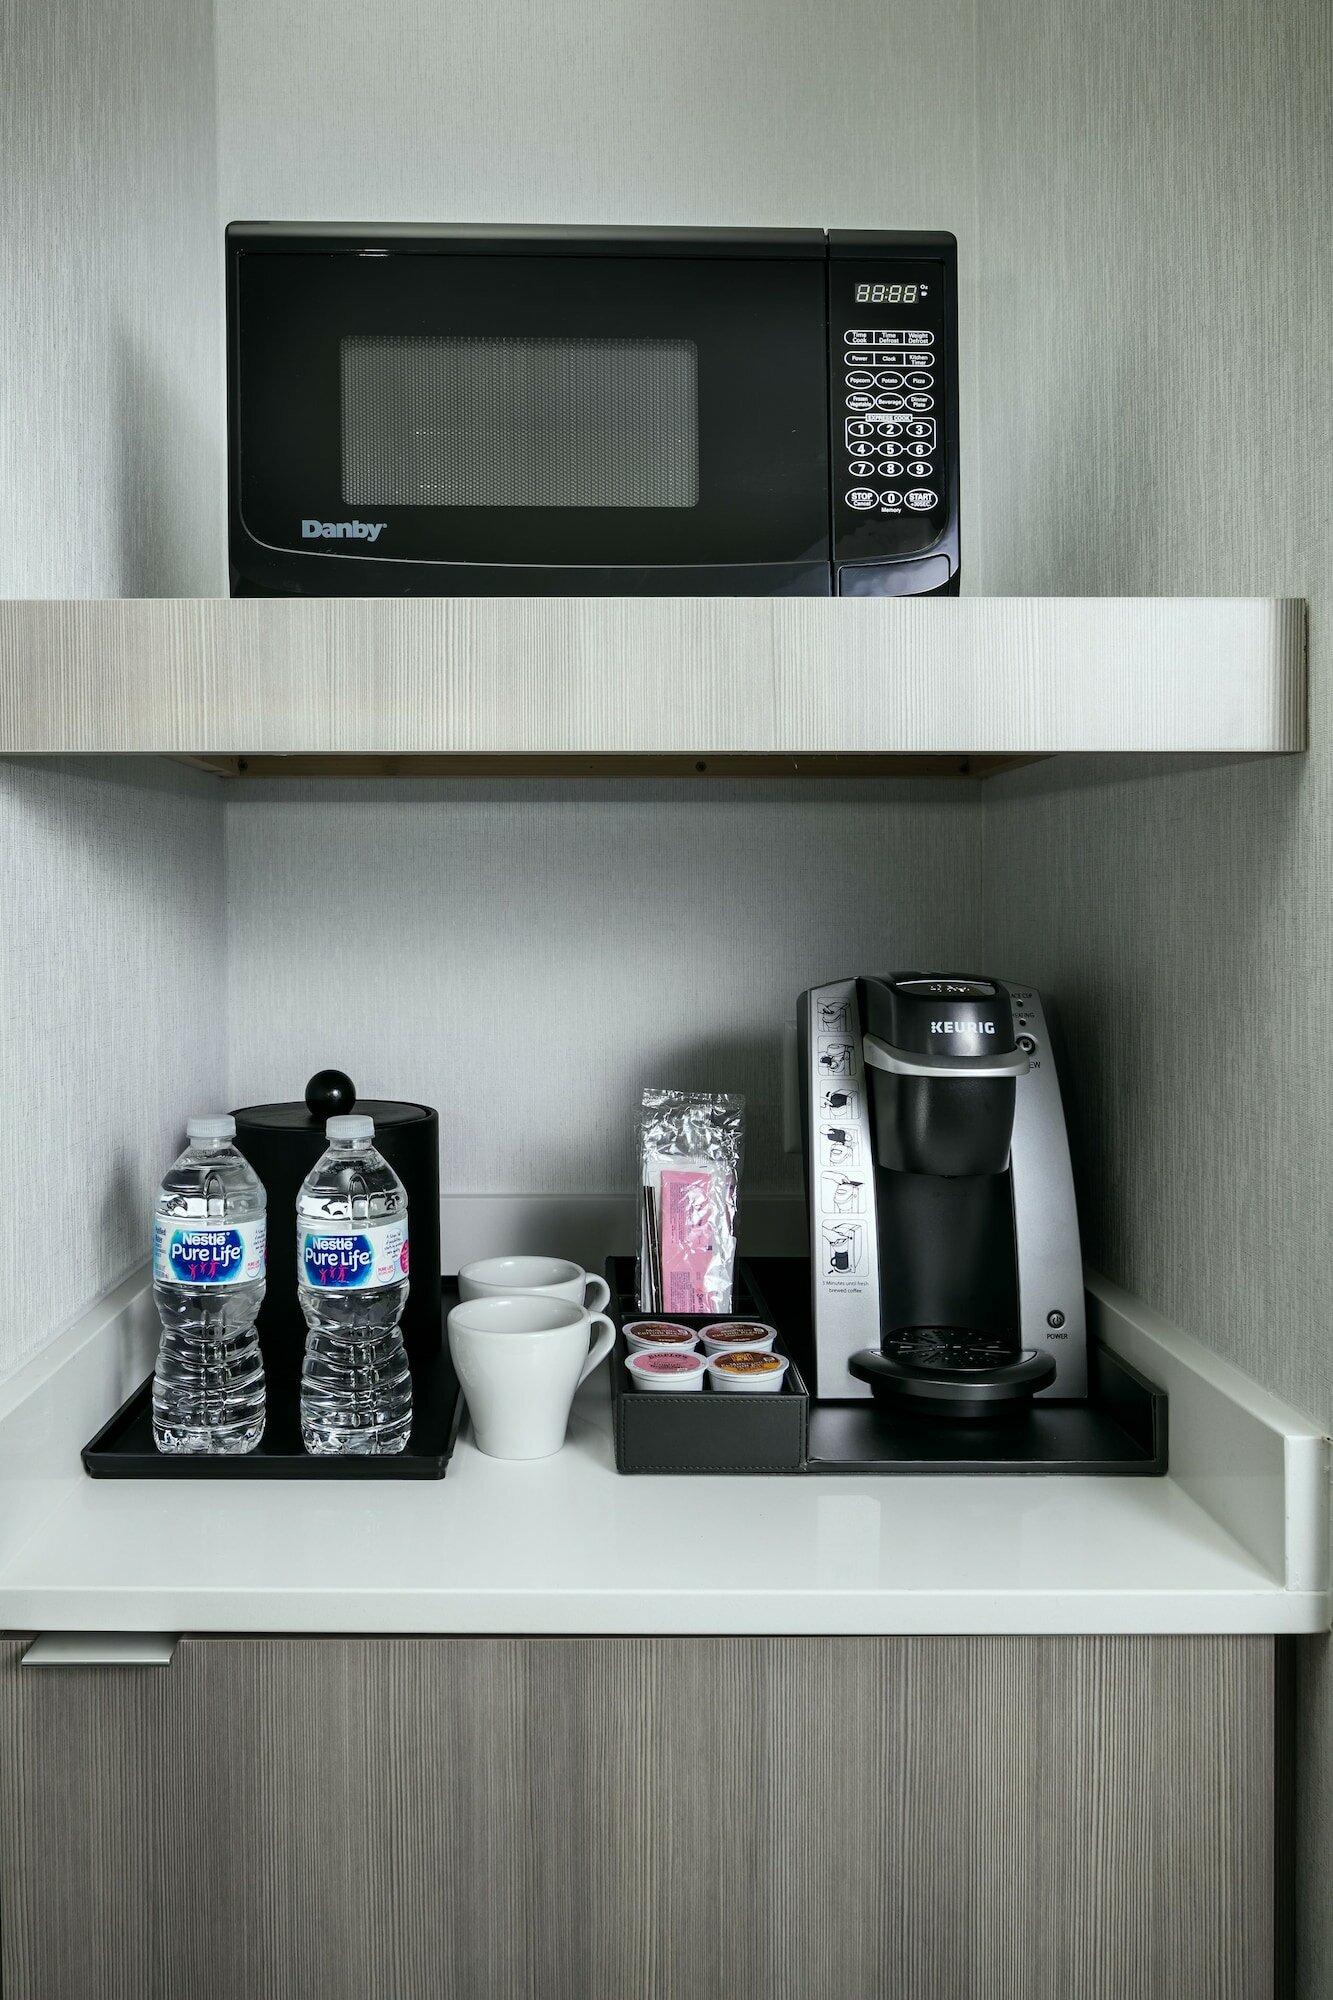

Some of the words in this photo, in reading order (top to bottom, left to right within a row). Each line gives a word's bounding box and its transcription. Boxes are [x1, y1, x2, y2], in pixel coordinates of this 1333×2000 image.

[858, 424, 864, 434] 1
[886, 424, 894, 434] 2
[915, 424, 923, 435] 3
[857, 444, 866, 454] 4
[886, 444, 894, 454] 5
[916, 444, 924, 455] 6
[858, 464, 866, 474] 7
[886, 464, 895, 474] 8
[915, 464, 924, 475] 9
[851, 492, 873, 500] STOP
[887, 493, 895, 504] 0
[301, 519, 384, 542] Danby
[931, 1021, 995, 1034] KEURIG
[1029, 1061, 1041, 1069] EW
[182, 1232, 226, 1246] Nestlé
[312, 1237, 354, 1251] Nestlé
[172, 1243, 210, 1261] Pure
[212, 1244, 241, 1267] Life
[305, 1247, 339, 1266] Pure
[340, 1249, 371, 1272] Life
